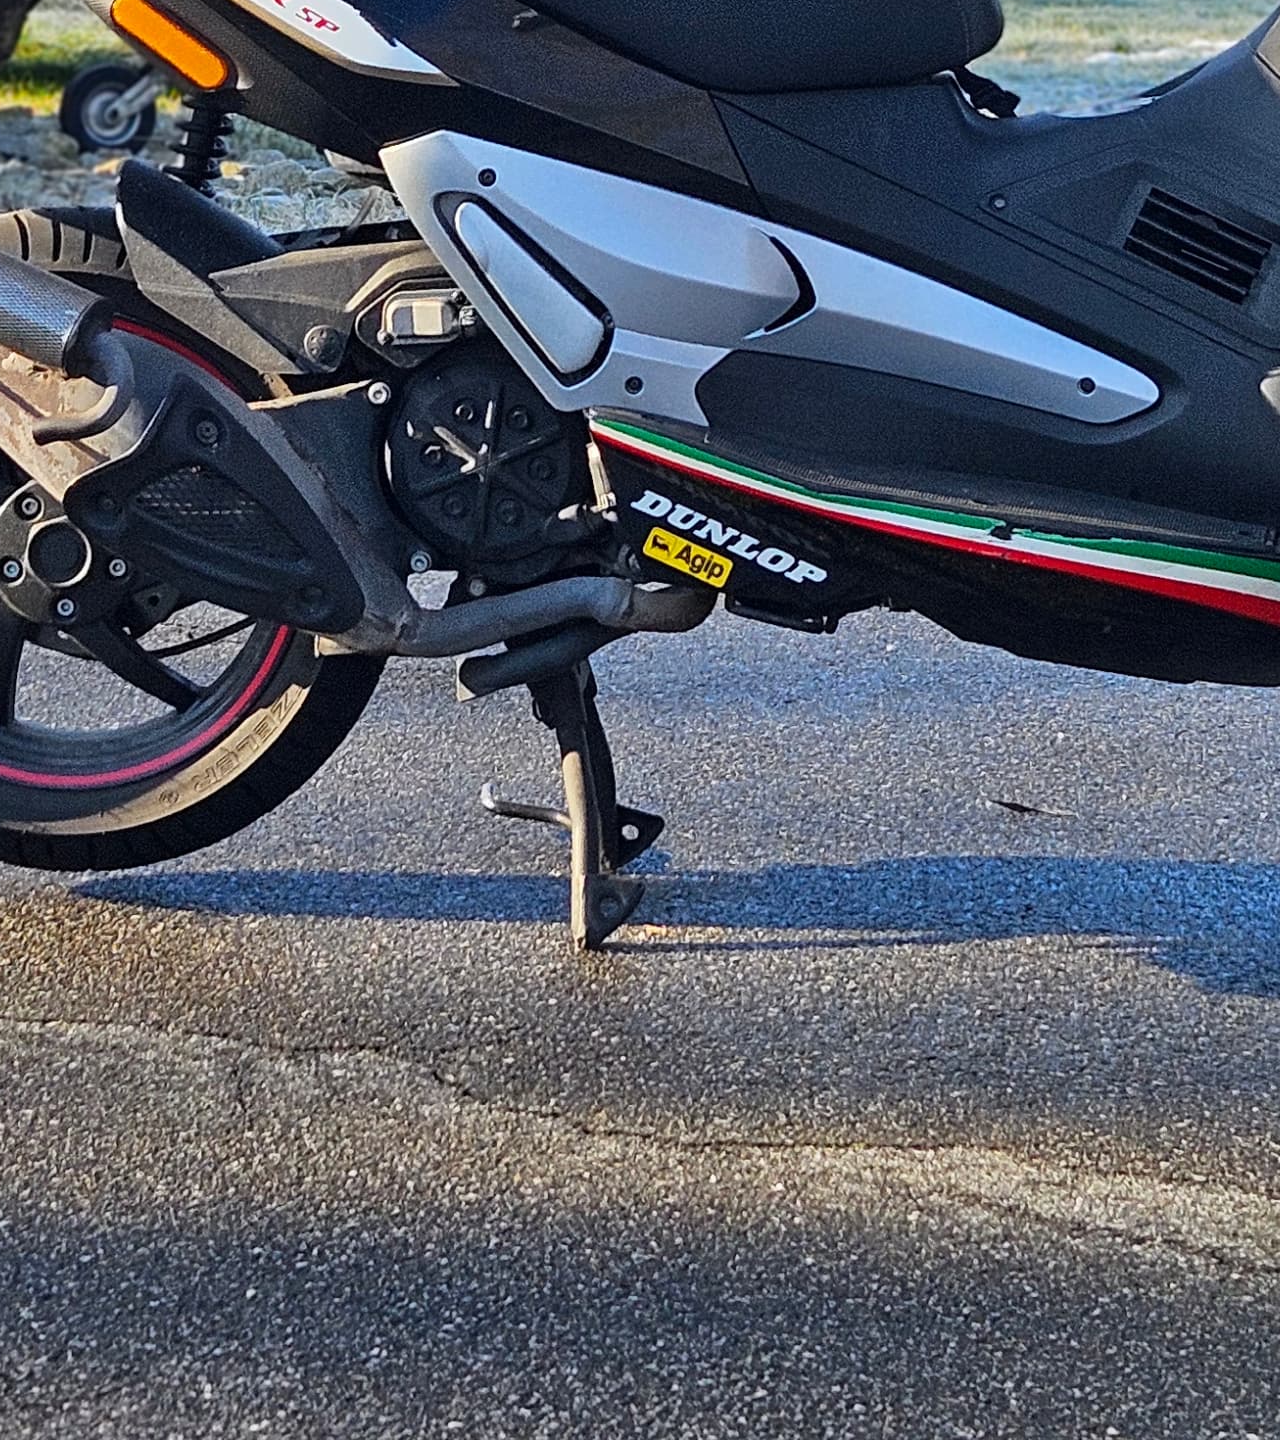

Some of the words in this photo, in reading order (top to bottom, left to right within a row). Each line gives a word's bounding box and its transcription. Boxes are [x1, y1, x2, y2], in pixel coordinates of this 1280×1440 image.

[295, 5, 341, 34] SP
[630, 489, 828, 584] DUNLOP
[674, 544, 725, 580] Agip
